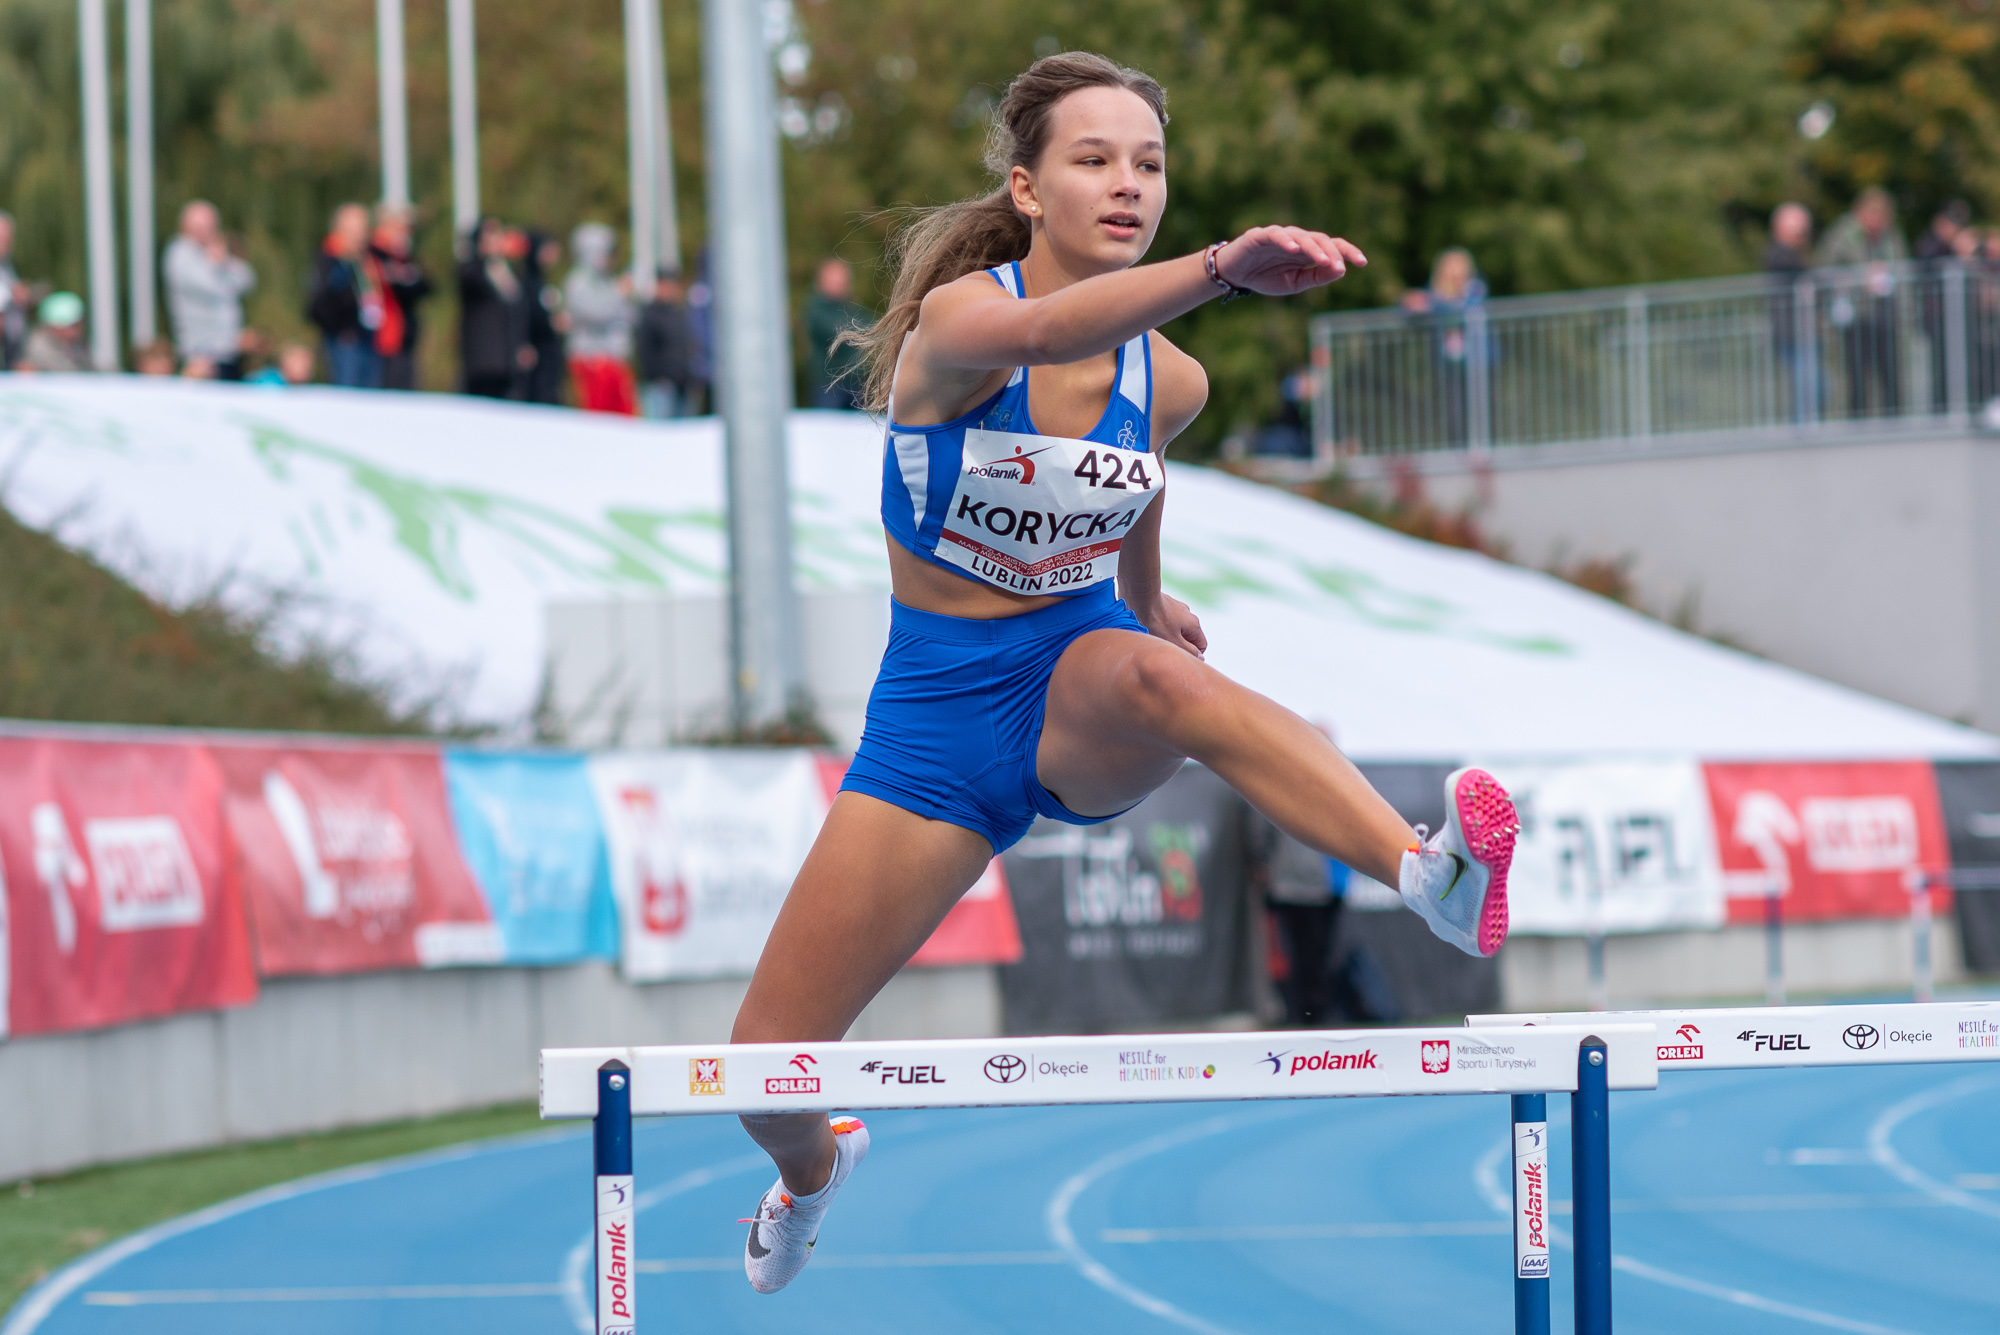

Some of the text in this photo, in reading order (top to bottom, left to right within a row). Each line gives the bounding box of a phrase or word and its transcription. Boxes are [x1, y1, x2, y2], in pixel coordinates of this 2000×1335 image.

[967, 464, 1021, 480] polanik
[1074, 450, 1152, 490] 424
[956, 494, 1137, 545] KORYCKA
[1054, 550, 1078, 562] POLSKI
[971, 555, 1093, 591] LUBLIN 2022
[1989, 1022, 1999, 1033] for
[1755, 1034, 1811, 1051] FUEL
[1889, 1030, 1933, 1044] Okęcie
[1457, 1046, 1515, 1055] Ministerstwo
[1657, 1046, 1701, 1059] ORLEN
[1155, 1053, 1167, 1064] for
[1290, 1049, 1378, 1076] polanik
[1457, 1059, 1488, 1070] Sportu
[1495, 1058, 1536, 1070] Turystyki
[882, 1066, 946, 1084] FUEL
[1038, 1061, 1089, 1077] Okęcie
[1119, 1066, 1200, 1081] HEALTHIER KIDS
[691, 1083, 722, 1094] PZLA
[767, 1078, 818, 1093] ORLEN
[1523, 1162, 1546, 1248] polanik
[606, 1221, 631, 1319] polanik
[1524, 1259, 1547, 1267] IAAF
